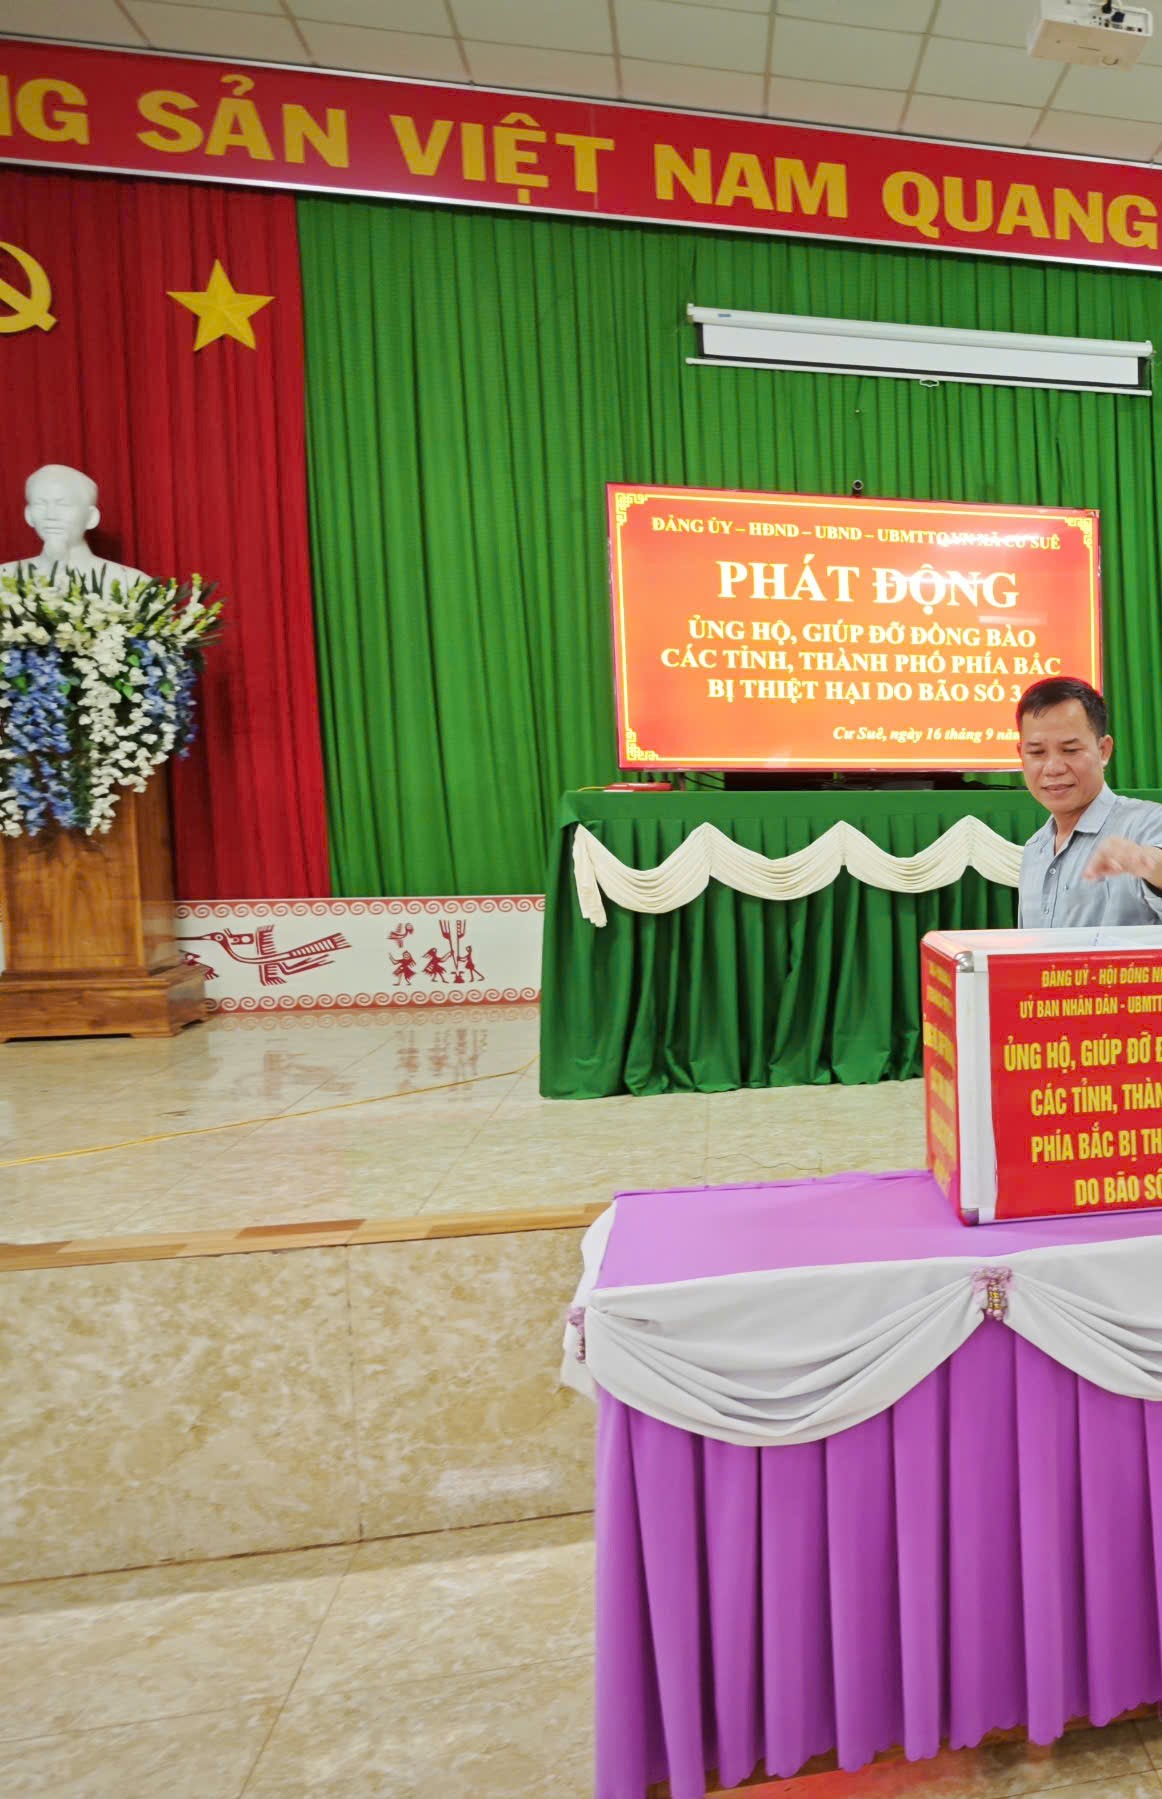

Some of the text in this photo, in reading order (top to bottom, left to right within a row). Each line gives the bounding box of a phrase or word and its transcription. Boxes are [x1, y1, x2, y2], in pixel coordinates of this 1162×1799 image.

[0, 74, 90, 145] G
[137, 74, 350, 169] SẢN
[390, 112, 615, 205] VIỆT
[654, 143, 849, 219] NAM
[881, 171, 1159, 251] QUANG
[652, 514, 704, 533] ĐẢNG
[708, 516, 733, 535] ỦY
[749, 522, 799, 538] HĐND
[815, 525, 863, 541] UBND
[1030, 533, 1061, 550] SUÊ
[716, 554, 1019, 615] PHÁT ĐỘNG
[688, 614, 1036, 648] ỦNG HỘ, GIÚP ĐỠ ĐỒNG BÀO
[660, 643, 1061, 676] CÁC TỈNH, THÀNH PHỐ PHÍA BẮC
[707, 678, 1021, 705] BỊ THIỆT HẠI DO BÃO SỐ 3
[833, 727, 855, 740] Cư
[856, 726, 887, 742] Suê,
[890, 727, 922, 744] ngày
[926, 727, 941, 741] 16
[944, 728, 982, 744] tháng
[985, 727, 994, 741] 9
[1041, 964, 1072, 988] ĐẢNG
[1074, 963, 1089, 986] UỶ
[1099, 964, 1118, 988] HỘI
[1020, 994, 1036, 1019] UỶ
[1037, 1000, 1060, 1018] BAN
[1062, 994, 1093, 1016] NHÂN
[1095, 993, 1119, 1014] DÂN
[1003, 1034, 1042, 1072] ỦNG
[1046, 1034, 1077, 1075] HỘ,
[1081, 1032, 1122, 1068] GIÚP
[1127, 1030, 1152, 1064] ĐỠ
[1030, 1082, 1068, 1117] CÁC
[1071, 1076, 1118, 1115] TỈNH,
[1031, 1128, 1075, 1164] PHÍA
[1077, 1121, 1115, 1161] BẮC
[1118, 1129, 1138, 1162] BỊ
[1074, 1176, 1101, 1207] DO
[1103, 1170, 1141, 1204] BÃO
